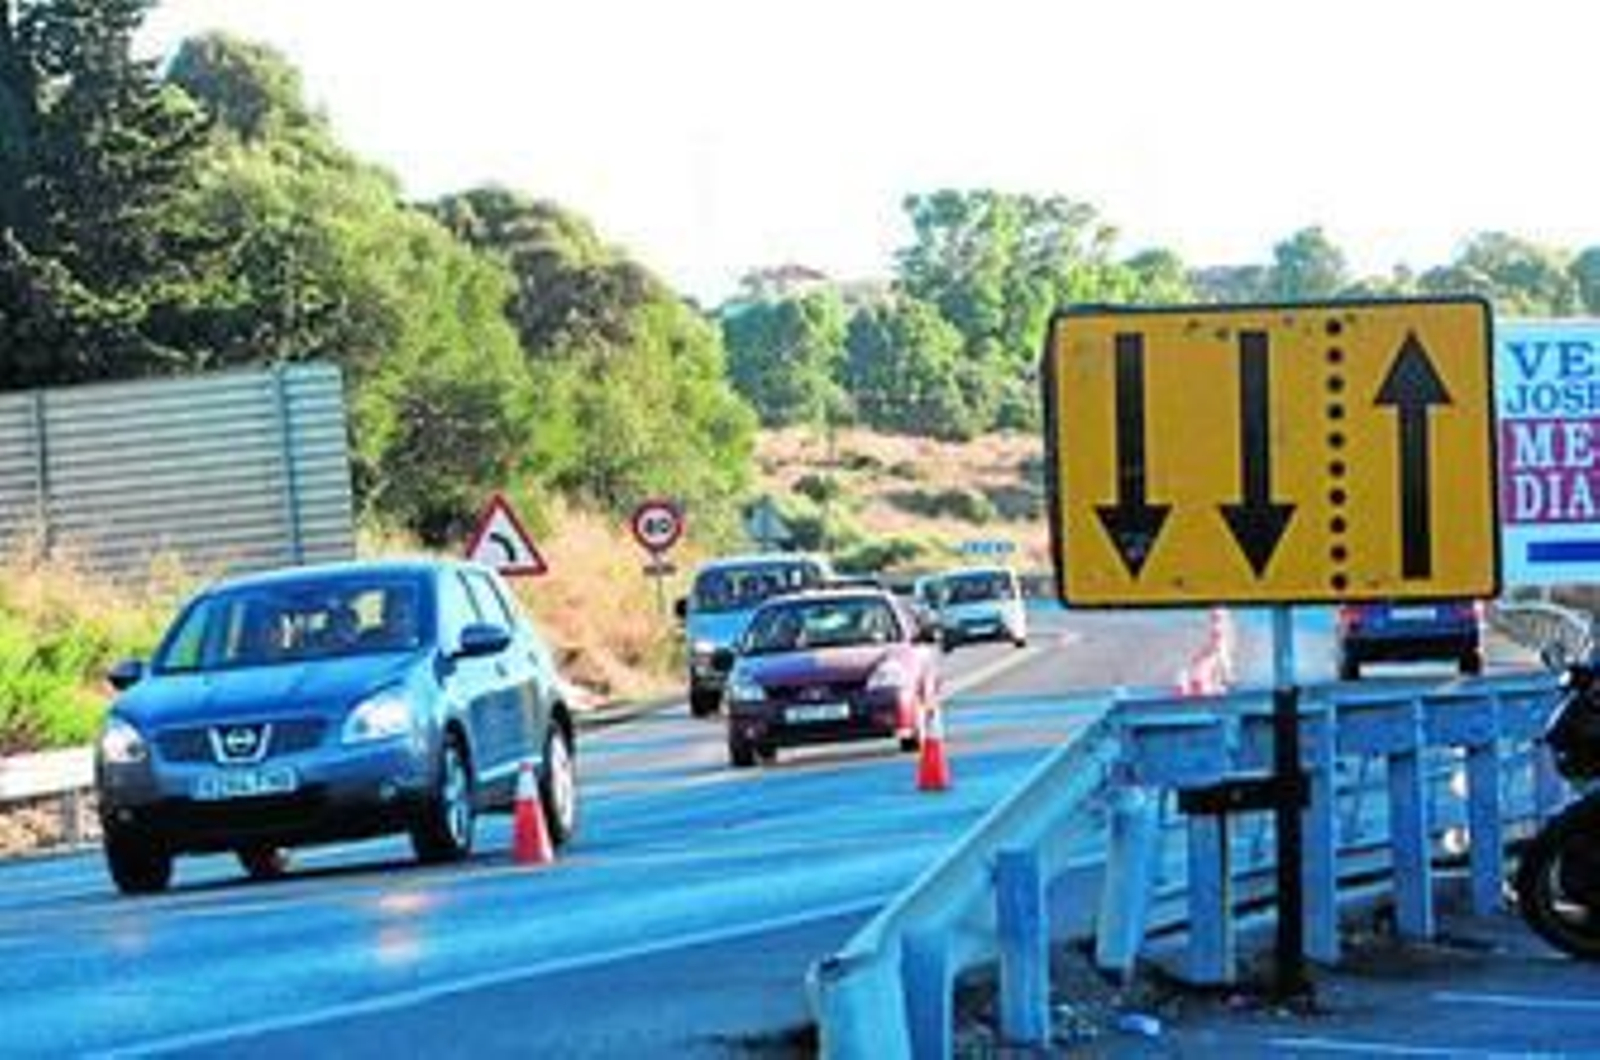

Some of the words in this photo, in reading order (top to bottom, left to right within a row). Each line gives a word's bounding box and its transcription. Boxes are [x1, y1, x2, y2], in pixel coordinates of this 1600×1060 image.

[1506, 341, 1595, 379] VE
[1513, 422, 1595, 468] ME
[1513, 473, 1595, 519] DIA
